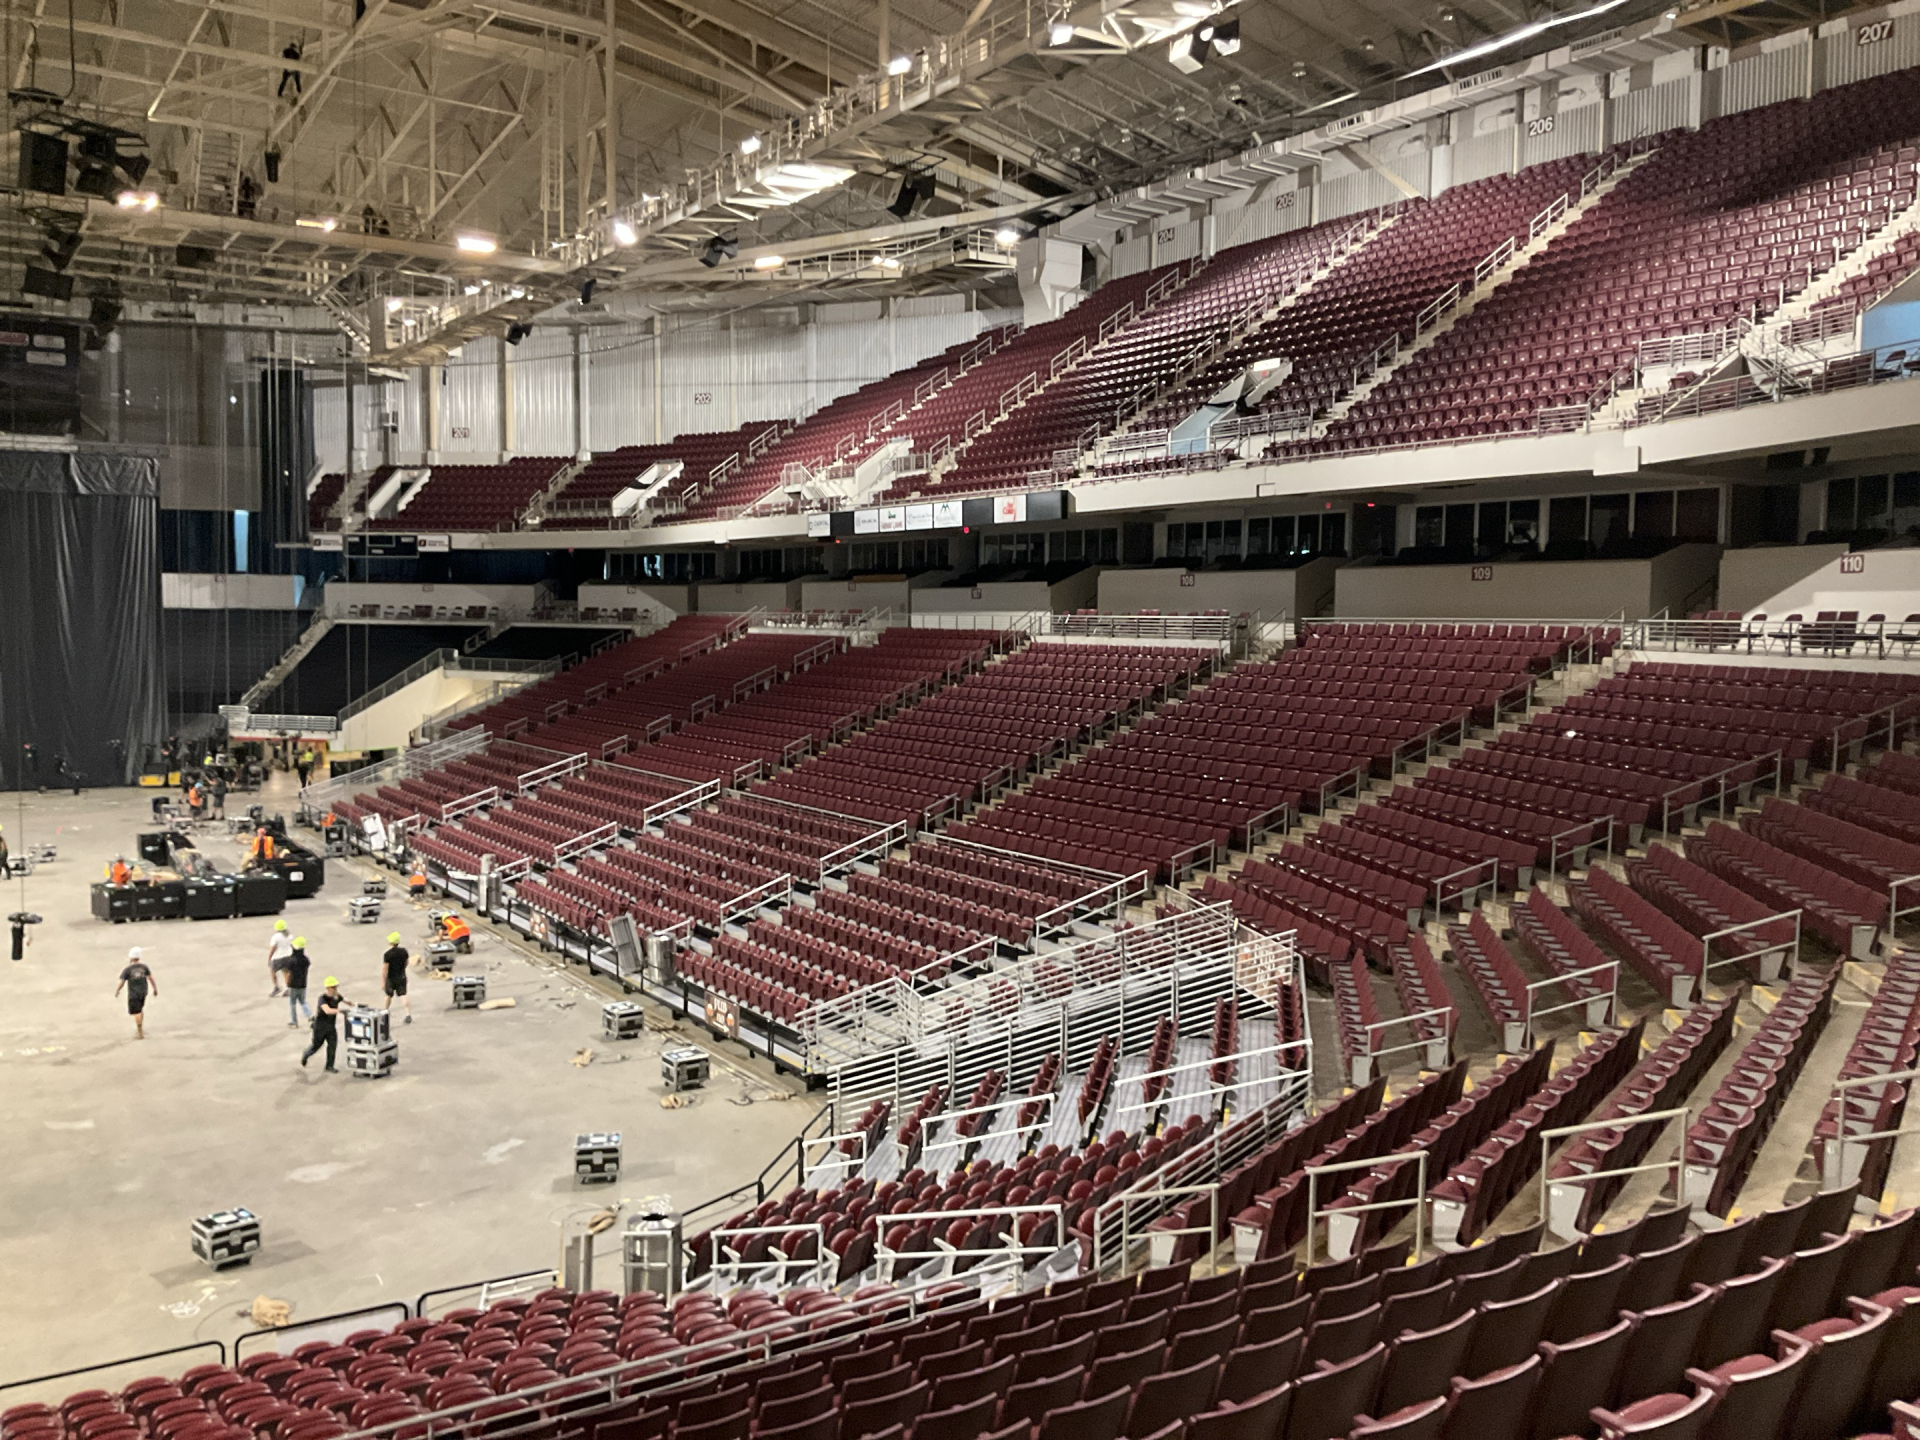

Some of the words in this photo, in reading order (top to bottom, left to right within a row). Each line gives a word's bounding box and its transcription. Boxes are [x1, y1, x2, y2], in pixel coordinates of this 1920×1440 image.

[1860, 20, 1893, 45] 207
[1529, 116, 1553, 137] 206
[1277, 193, 1294, 209] 205
[1158, 229, 1173, 243] 204
[695, 394, 710, 404] 202
[1842, 556, 1862, 572] 110
[1181, 575, 1194, 586] 108
[1473, 567, 1491, 580] 109
